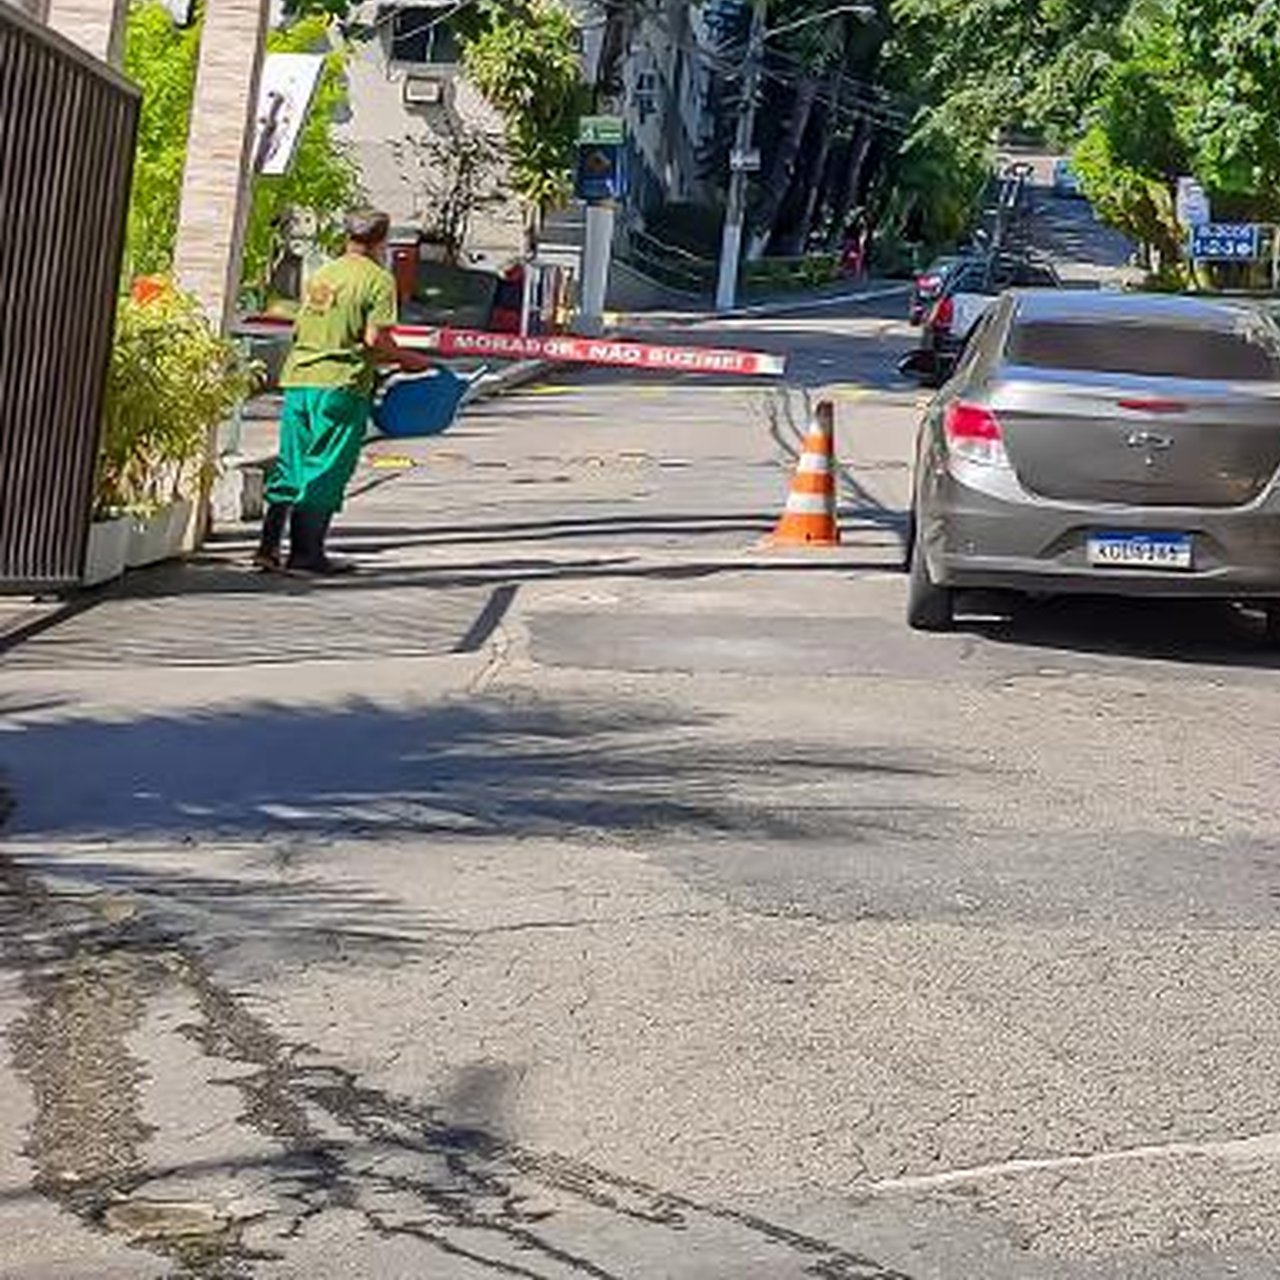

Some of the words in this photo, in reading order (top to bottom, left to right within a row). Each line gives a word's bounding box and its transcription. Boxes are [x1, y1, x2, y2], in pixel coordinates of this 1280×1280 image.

[454, 334, 583, 357] MORADOR,
[589, 342, 641, 363] NÃO
[649, 350, 745, 371] BUZINE!
